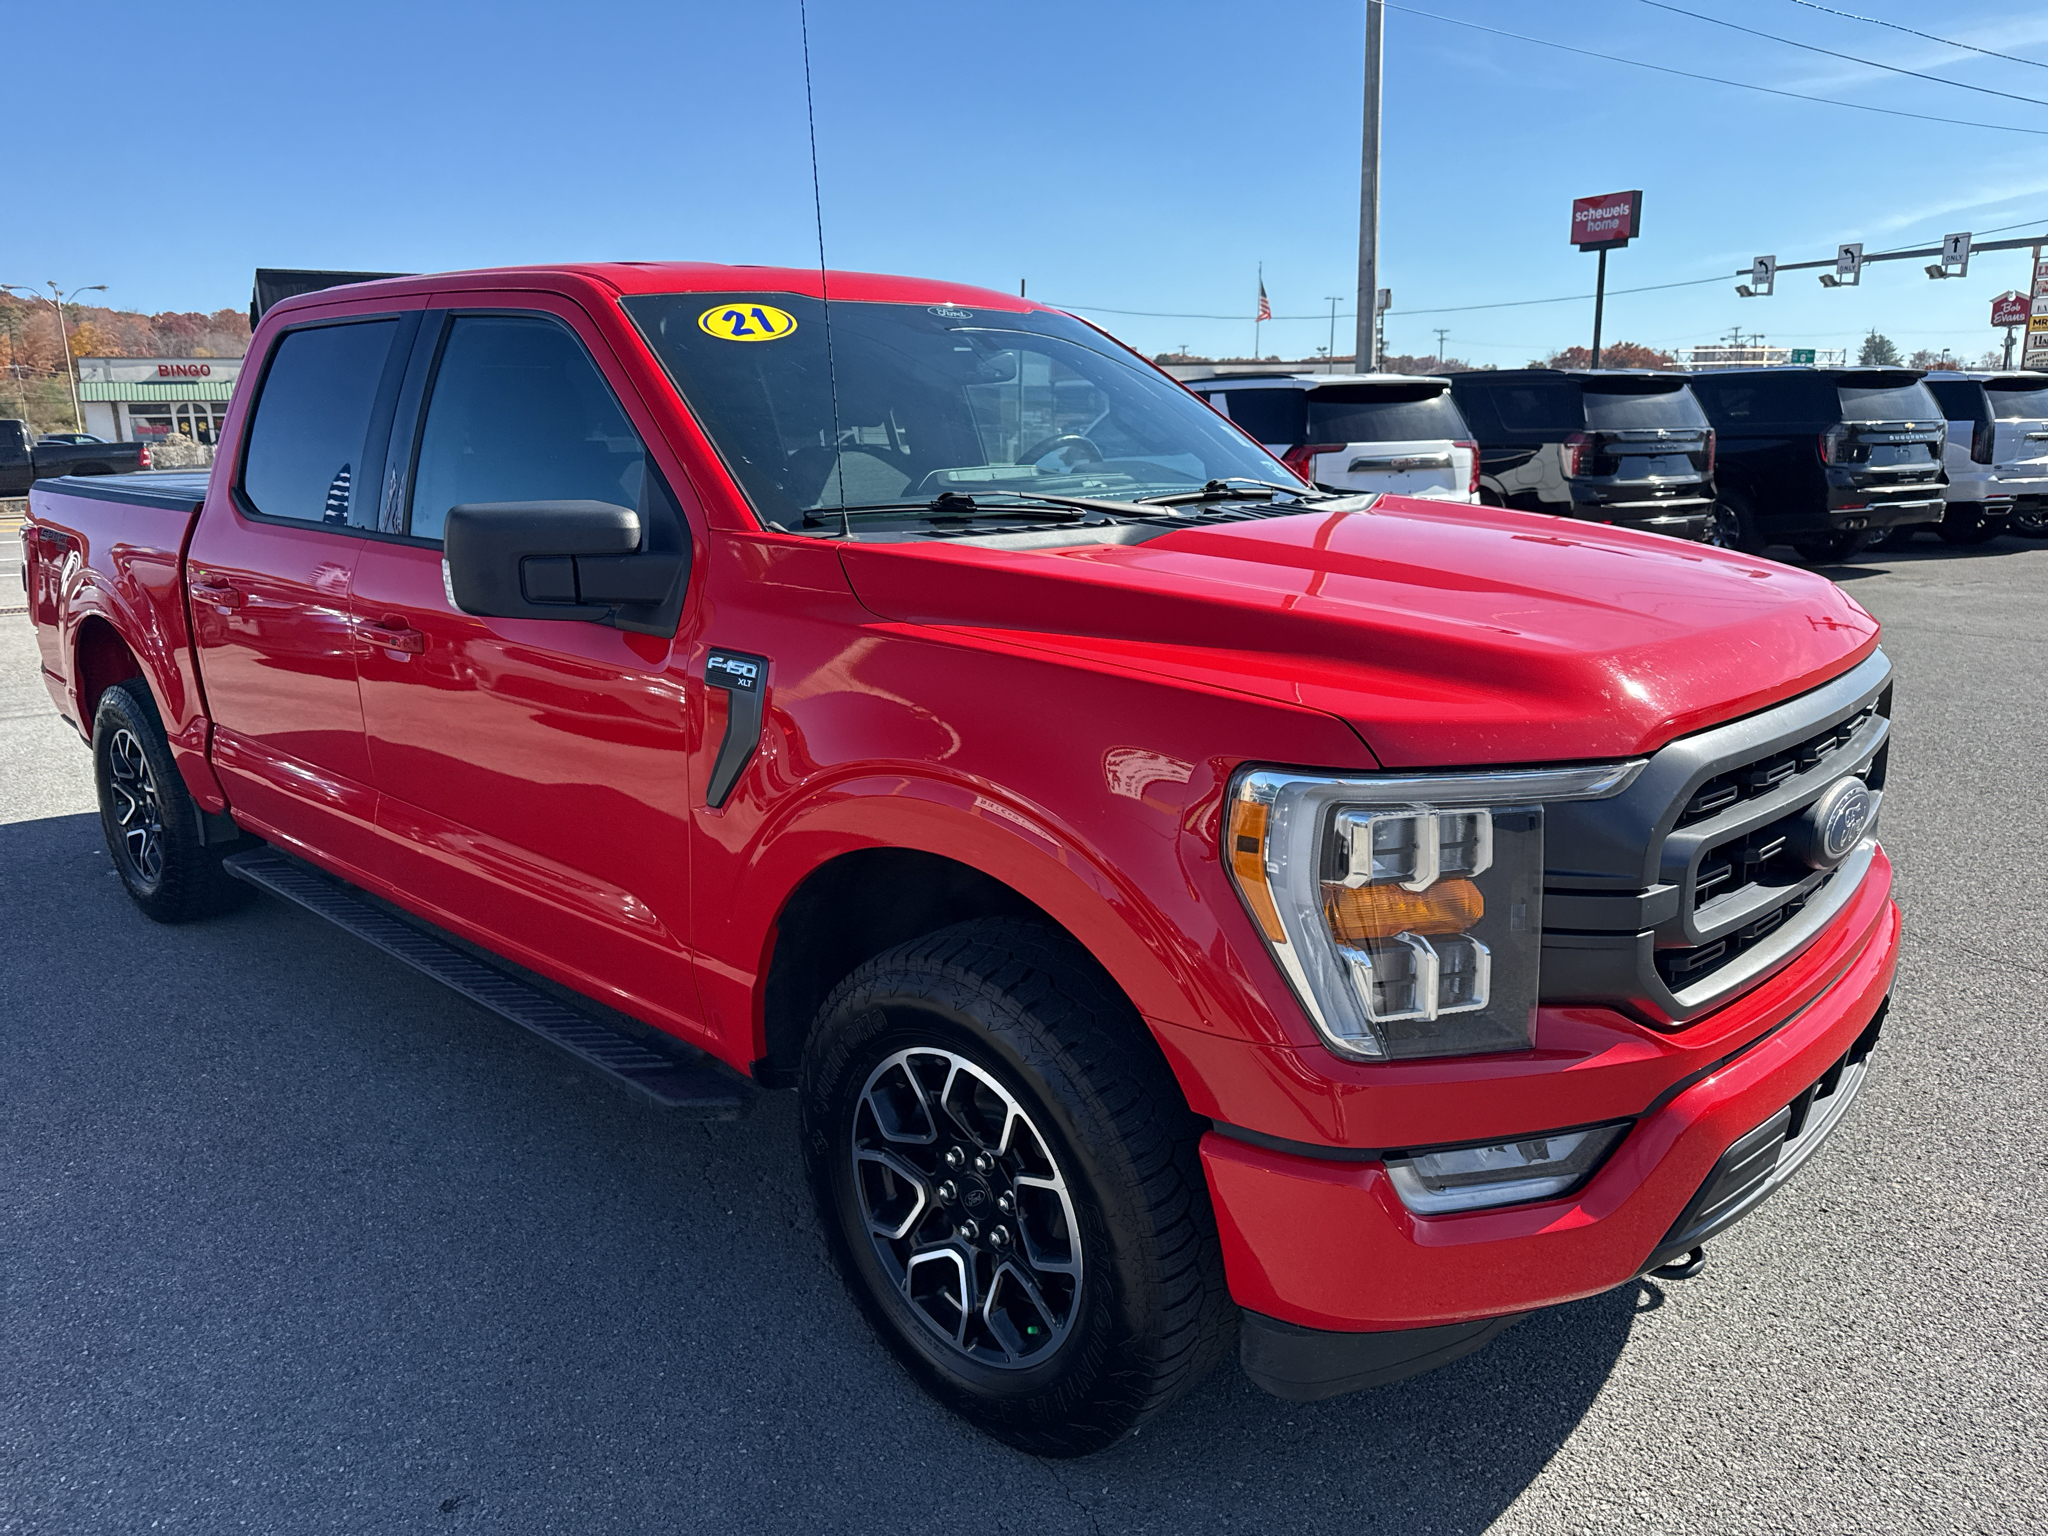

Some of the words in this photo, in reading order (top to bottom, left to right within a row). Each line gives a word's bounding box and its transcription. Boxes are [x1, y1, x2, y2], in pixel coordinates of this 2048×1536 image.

[1575, 203, 1630, 222] schewels
[1587, 218, 1619, 232] home
[1945, 254, 1963, 262] ONLY
[1839, 264, 1857, 272] ONLY
[1754, 275, 1770, 283] ONLY
[2001, 302, 2021, 313] Bob
[722, 308, 775, 337] 21
[1993, 311, 2026, 324] Evans
[158, 364, 211, 377] BINGO
[708, 657, 758, 678] F-150
[737, 678, 752, 687] XLT
